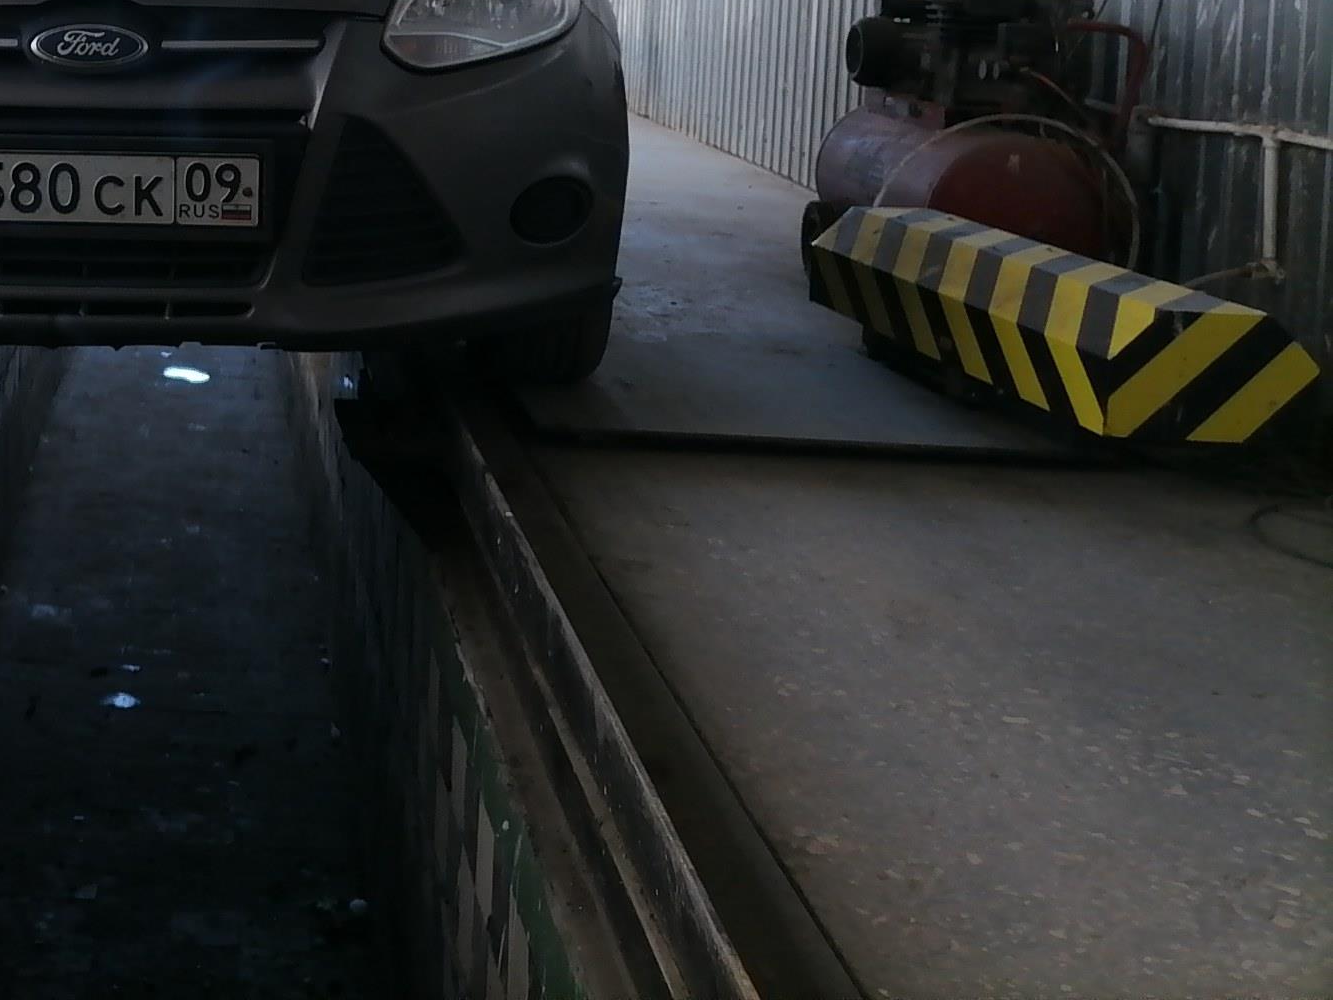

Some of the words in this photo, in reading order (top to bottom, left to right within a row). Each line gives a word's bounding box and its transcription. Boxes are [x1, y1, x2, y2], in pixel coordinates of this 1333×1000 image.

[56, 30, 121, 56] Ford
[183, 161, 243, 203] 09
[177, 203, 221, 220] RUS
